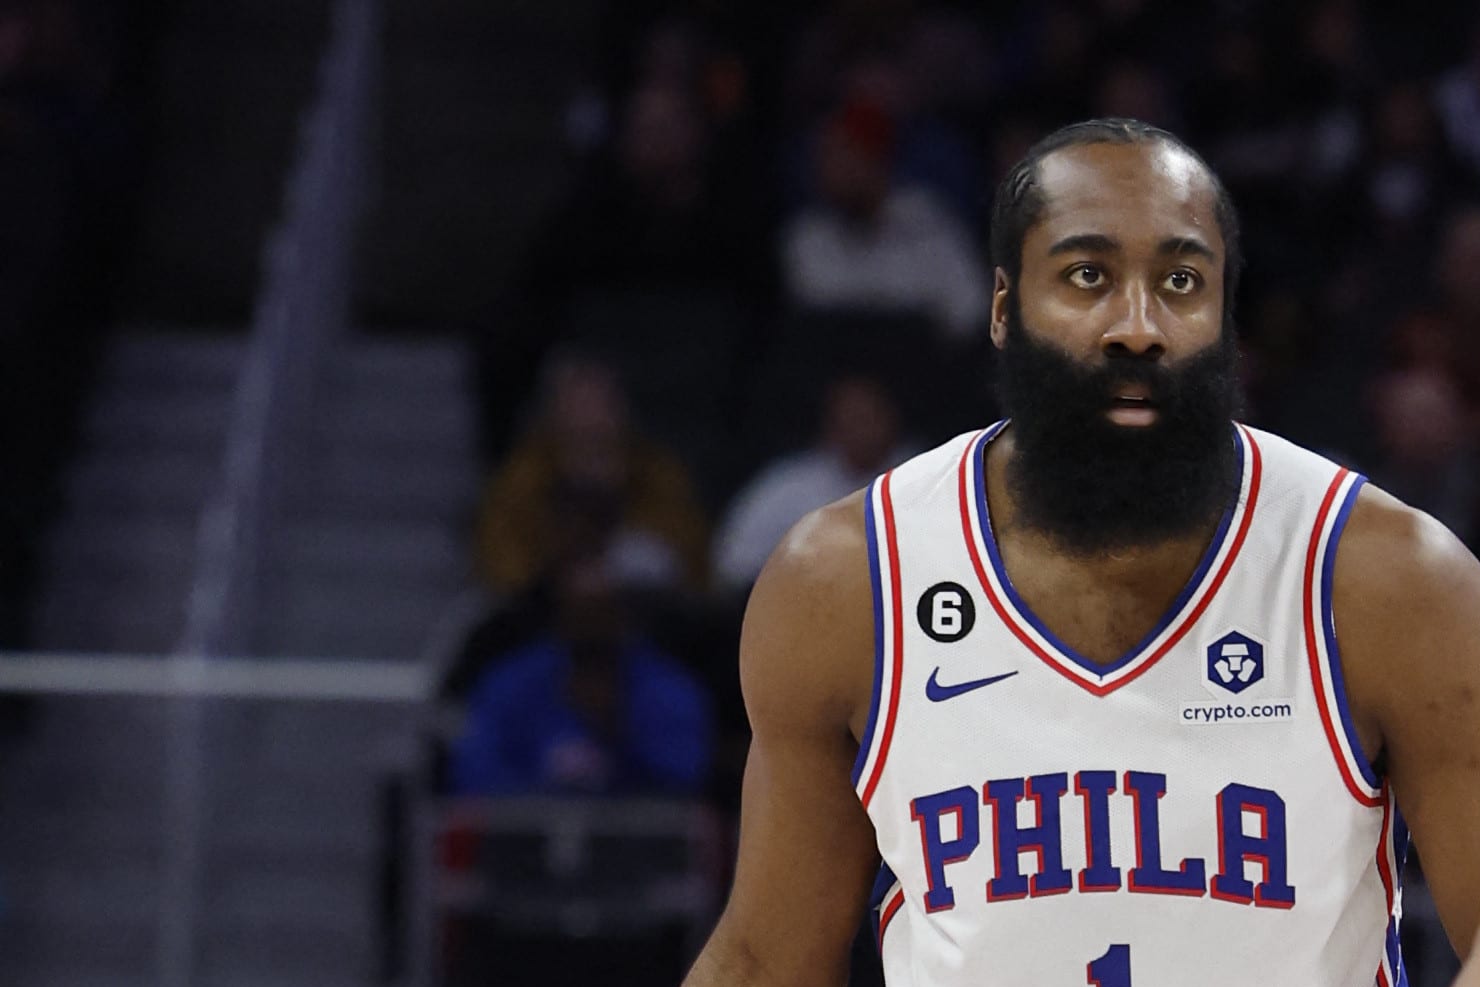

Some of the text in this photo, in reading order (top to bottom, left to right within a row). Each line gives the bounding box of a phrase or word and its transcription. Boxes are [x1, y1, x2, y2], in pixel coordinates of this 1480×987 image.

[931, 591, 962, 635] 6
[1183, 704, 1291, 721] crypto.com
[910, 770, 1296, 914] PHILA
